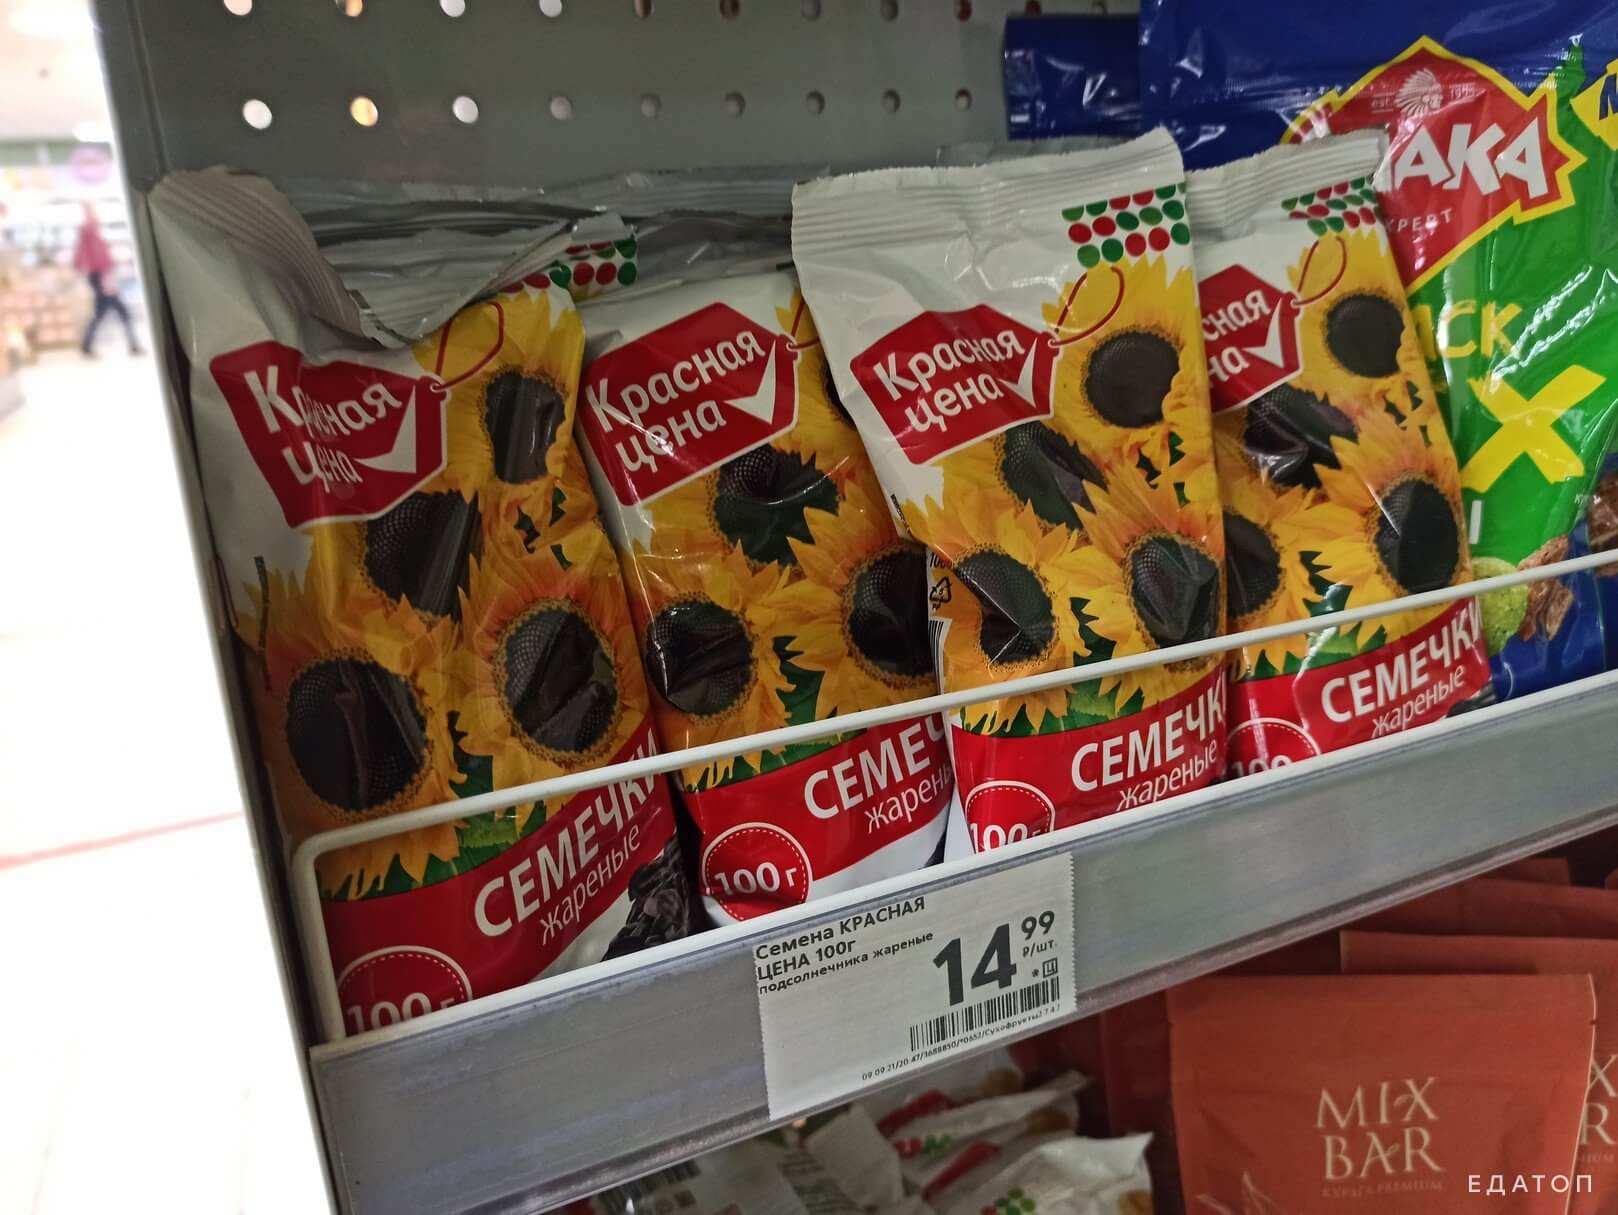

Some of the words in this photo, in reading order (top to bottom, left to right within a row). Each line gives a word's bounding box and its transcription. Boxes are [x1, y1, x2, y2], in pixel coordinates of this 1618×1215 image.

[585, 330, 766, 433] Красная
[873, 331, 1025, 401] Красная
[904, 373, 1004, 433] цена
[282, 440, 364, 494] цена
[616, 399, 727, 473] цена
[1321, 601, 1482, 723] СЕМЕЧКИ
[1371, 664, 1466, 738] жареные
[1116, 739, 1217, 812] жареные
[538, 823, 641, 945] жареные
[714, 862, 780, 896] 100
[756, 928, 834, 960] Семена
[839, 896, 925, 936] КРАСНАЯ
[932, 922, 1017, 1006] 14
[1021, 910, 1055, 941] 99
[757, 953, 810, 981] ЦЕНА
[815, 940, 856, 962] 100г
[759, 954, 868, 994] подсолнечника
[872, 932, 934, 959] жареные
[346, 992, 432, 1033] 100
[1314, 1077, 1440, 1129] MIX
[1322, 1126, 1444, 1181] BAR
